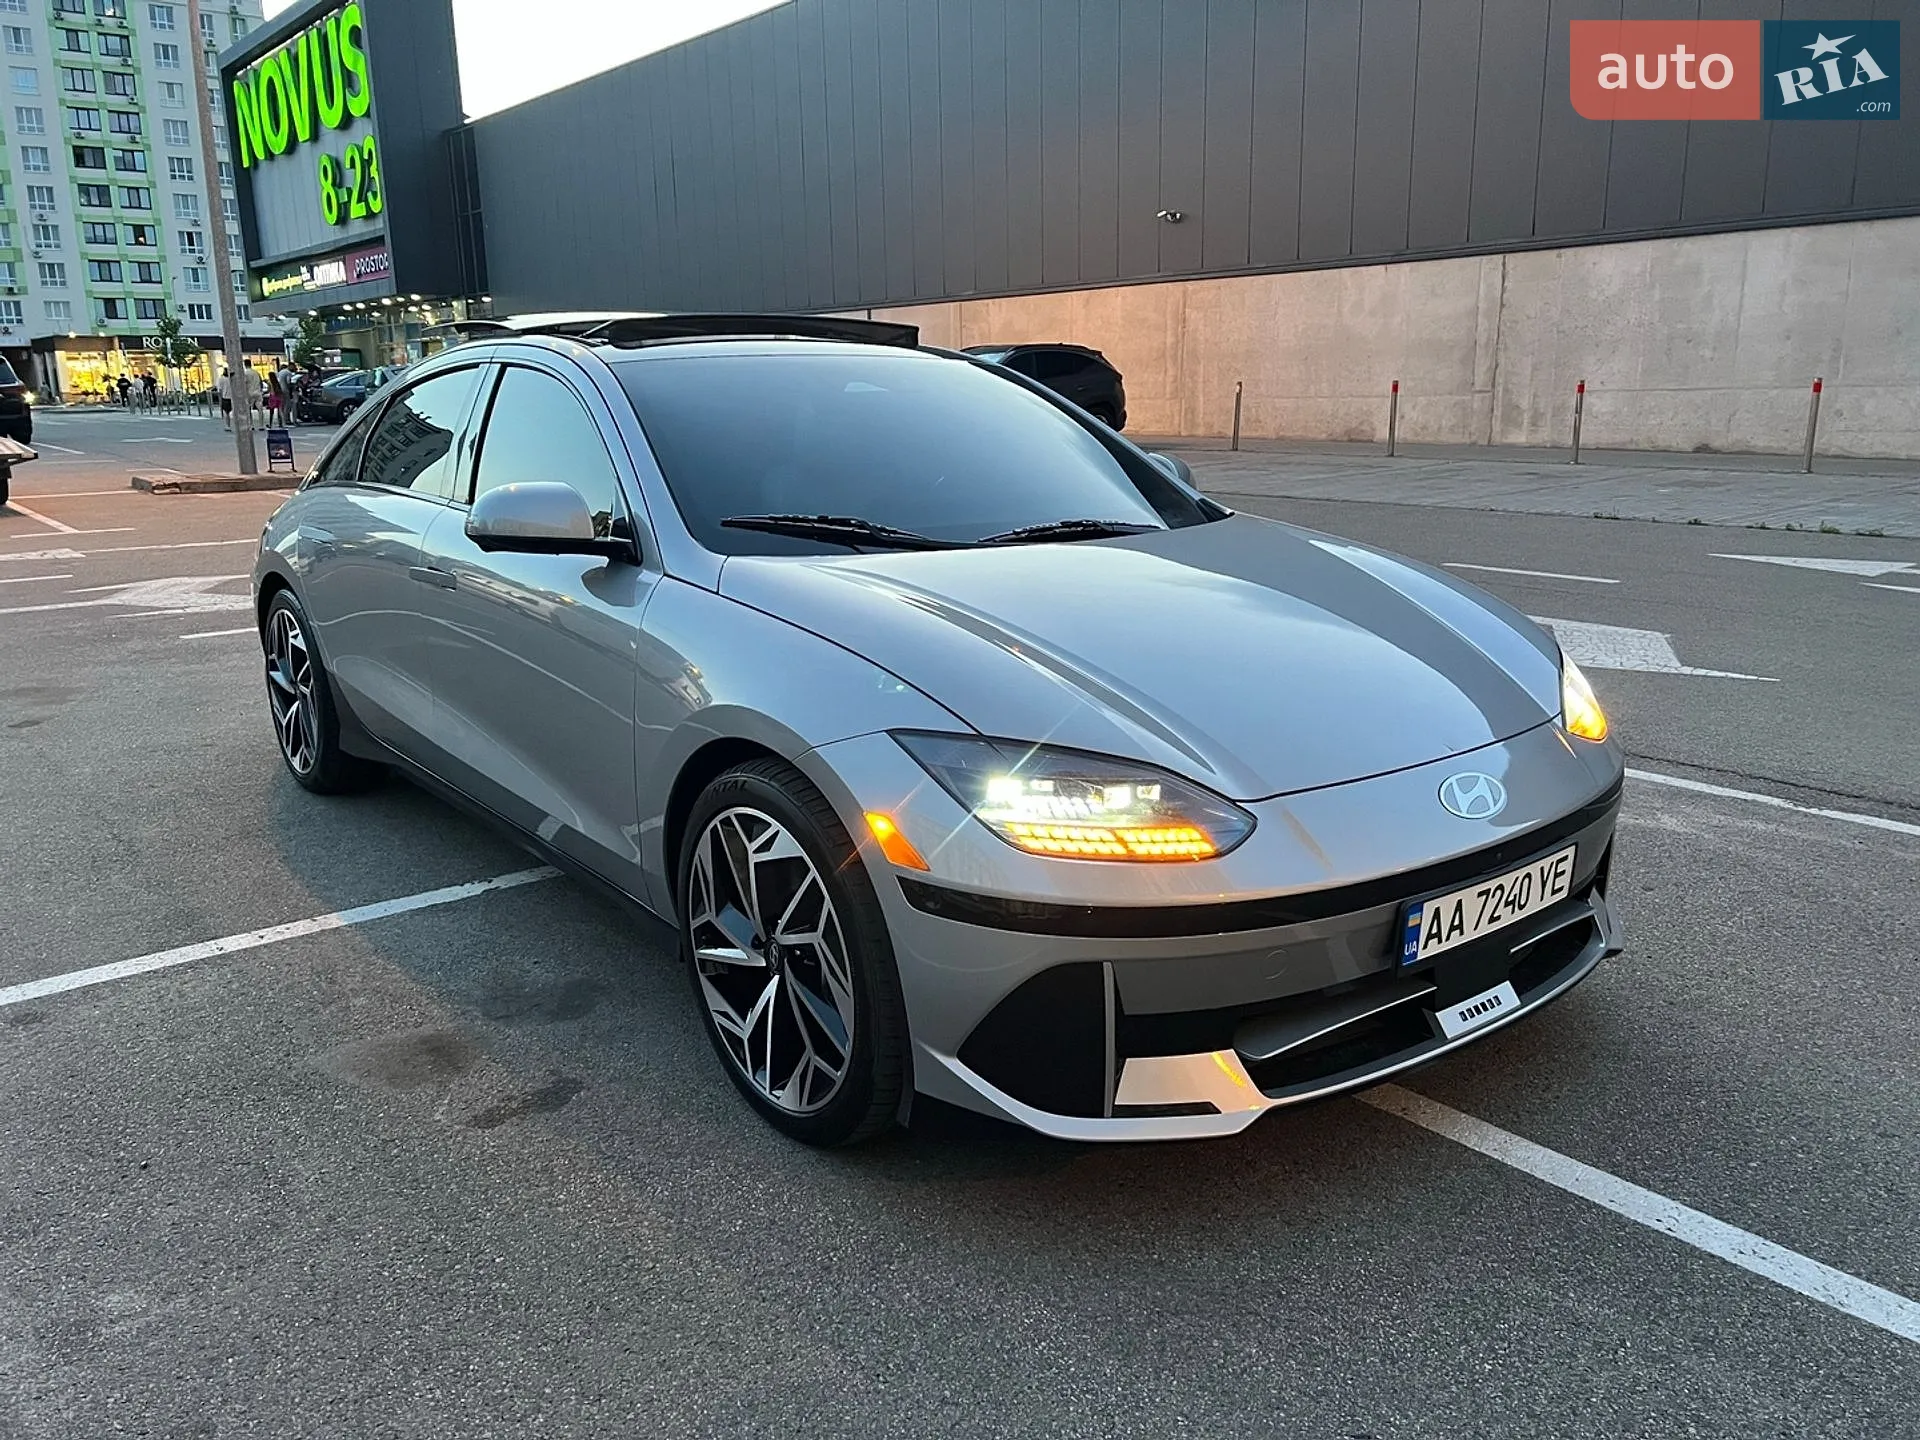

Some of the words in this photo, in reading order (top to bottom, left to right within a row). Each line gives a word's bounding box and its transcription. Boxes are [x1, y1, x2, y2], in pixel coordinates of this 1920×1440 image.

[233, 3, 371, 168] NOVUS
[318, 134, 383, 226] 8-23
[1404, 940, 1417, 956] UA
[1422, 899, 1464, 950] AA
[1473, 872, 1532, 932] 7240
[1539, 854, 1569, 902] YE
